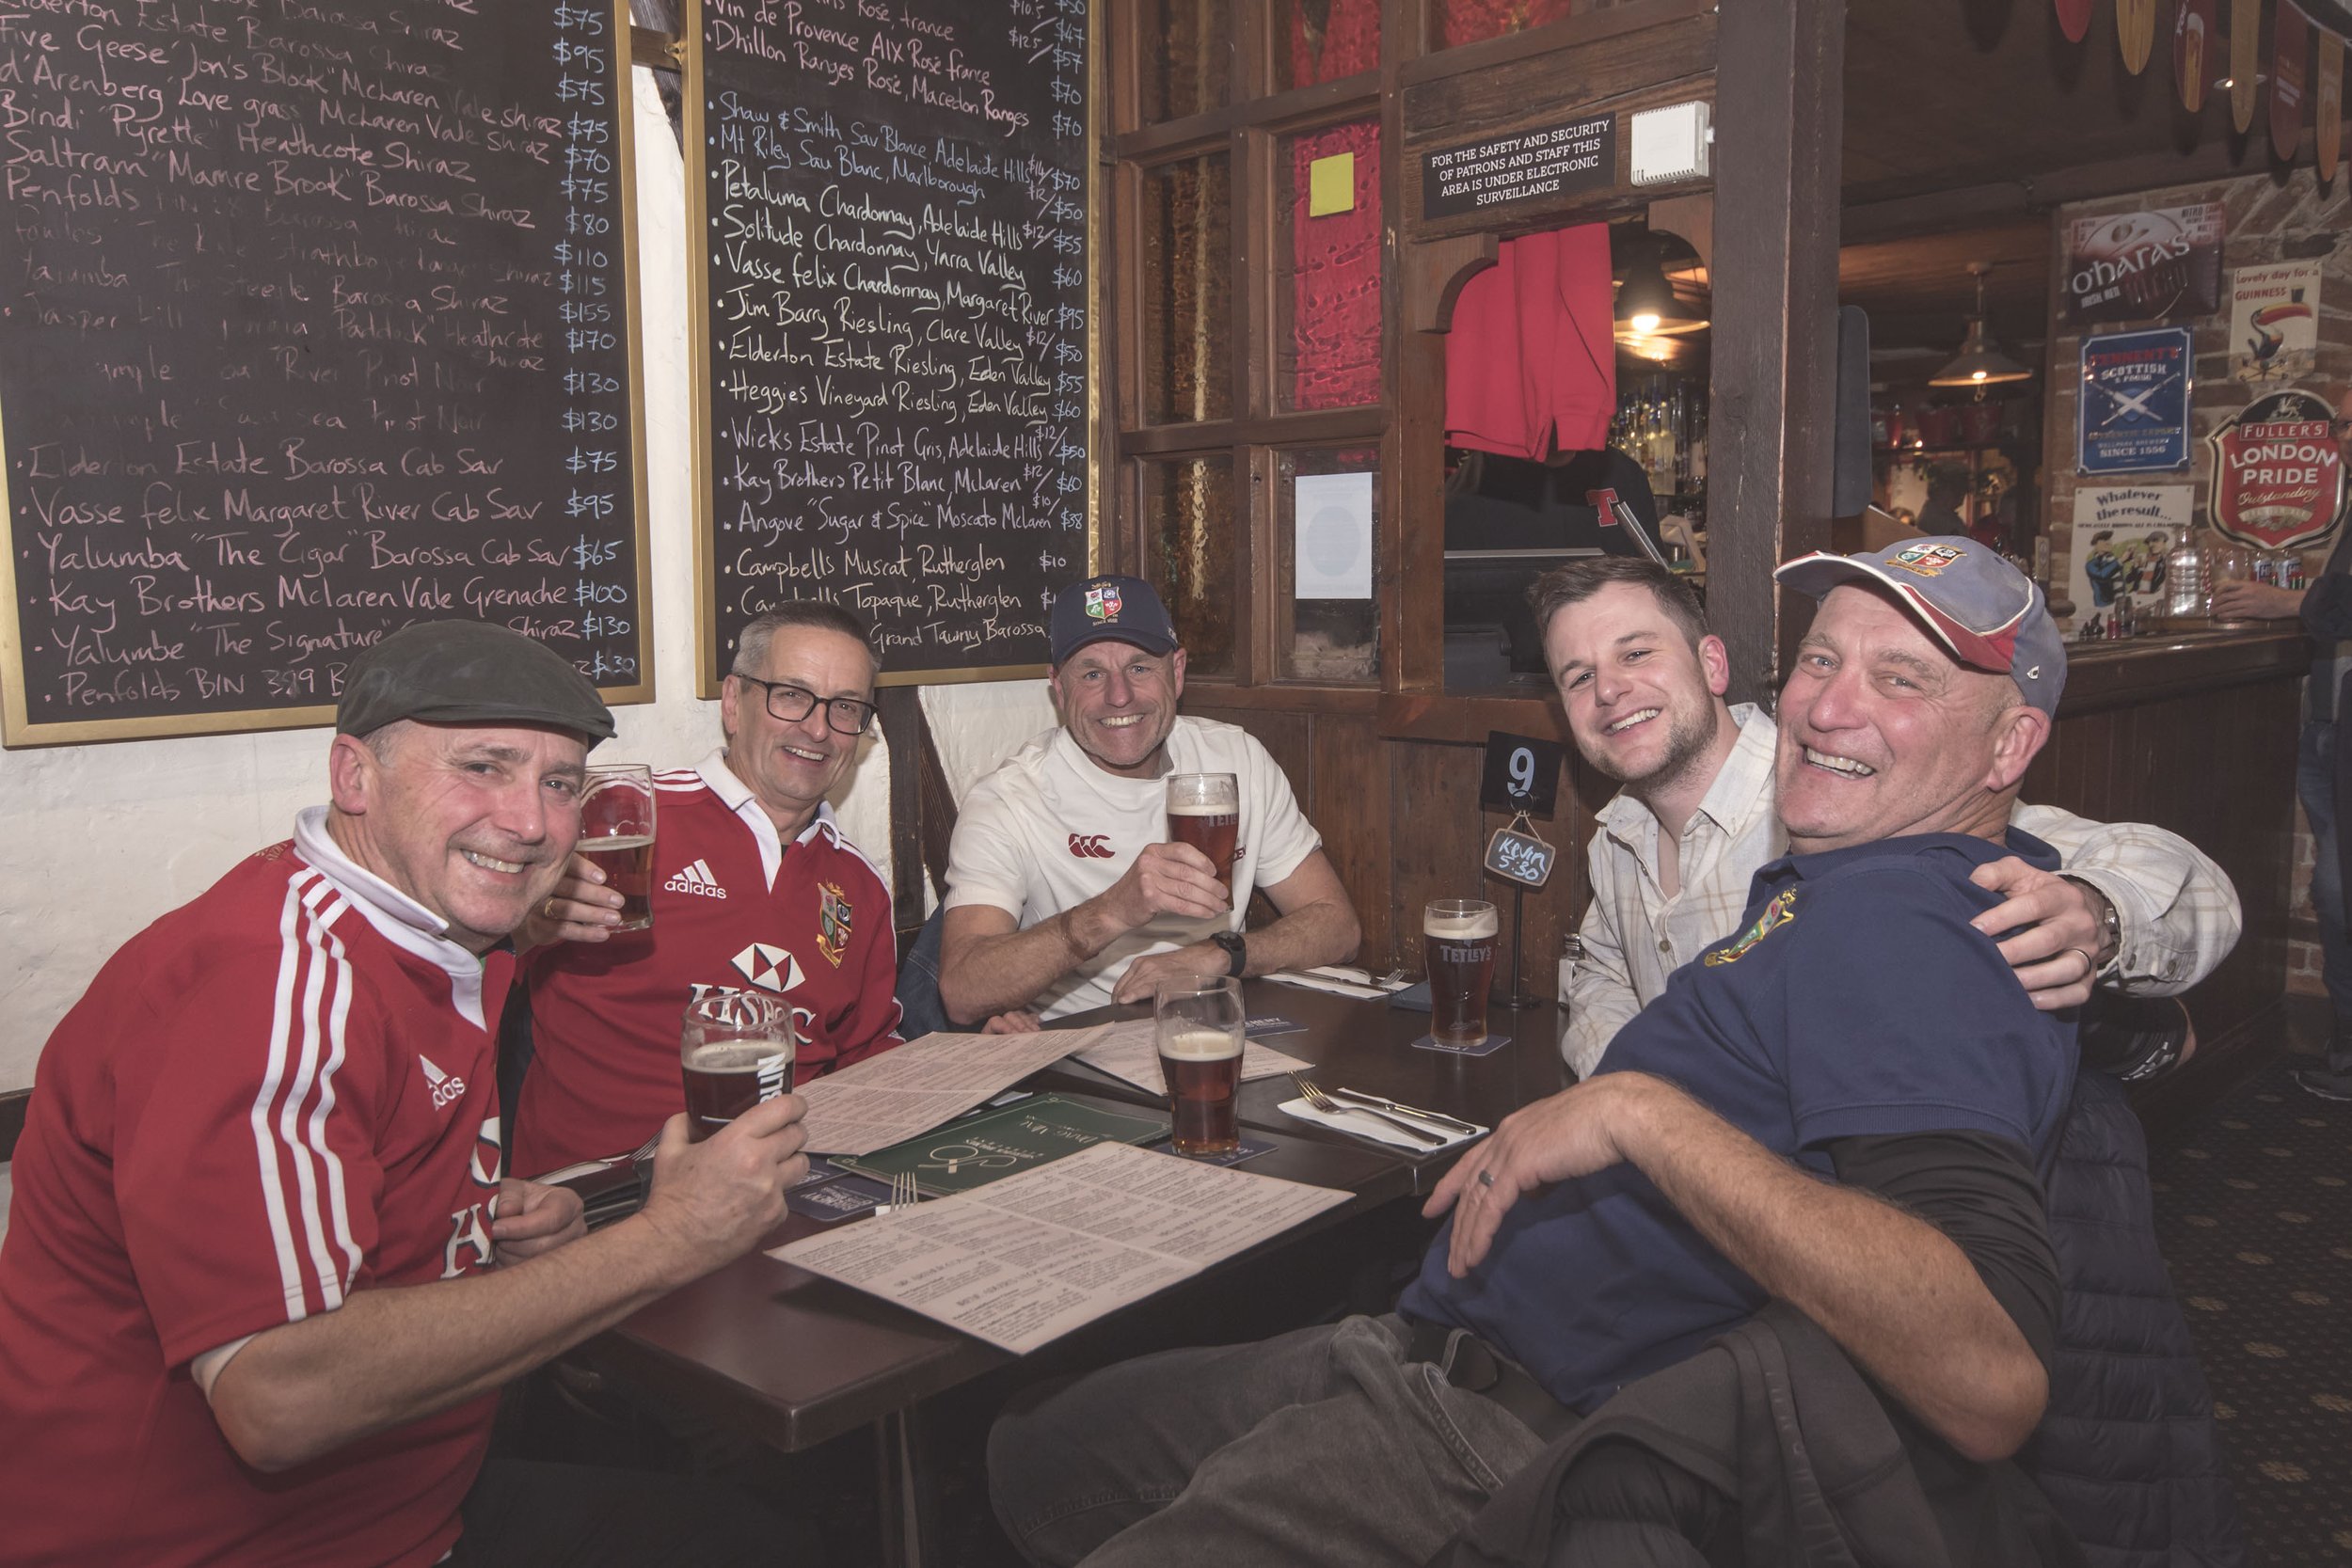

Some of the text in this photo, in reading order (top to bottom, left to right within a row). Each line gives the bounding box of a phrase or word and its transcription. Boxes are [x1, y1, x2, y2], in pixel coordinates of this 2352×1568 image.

[76, 24, 171, 66] Geese
[785, 2, 1082, 104] Provence $70
[555, 71, 605, 106] $75
[712, 20, 1082, 141] Dhillon Ranges Macedon Ranges $70
[566, 110, 610, 144] $75
[719, 92, 1081, 192] Shaw Smith Sav Adelaide $70
[1431, 119, 1610, 168] FOR THE SAFETY AND SECURITY
[5, 130, 151, 179] Saltram
[564, 141, 611, 174] $70
[721, 123, 1083, 224] Mt Riley Marlborough $50
[1439, 138, 1601, 182] OF PATRONS AND STAFF THIS
[561, 172, 609, 207] $75
[1441, 156, 1599, 198] AREA IS UNDER ELECTRONIC
[1476, 181, 1560, 206] SURVEILLANCE
[564, 205, 611, 235] $80
[724, 158, 1083, 254] Petaluma Adelaide Hills $55
[723, 204, 804, 248] Solitude
[978, 250, 1026, 292] Valley
[1053, 262, 1082, 290] $60
[725, 240, 1085, 331] Vasse Margaret River $95
[2235, 286, 2287, 302] GUINNESS
[2236, 271, 2267, 285] Lovely
[2270, 268, 2291, 282] day
[2294, 267, 2309, 279] for
[724, 284, 1083, 367] Jim Barry Clare Valley $50
[729, 326, 1085, 399] Elderton Estate Eden Valley $55
[2101, 363, 2168, 381] SCOTTISH
[728, 368, 1081, 428] Heggies Vineyard Eden Valley $60
[730, 415, 1087, 467] Wicks Estate Pinot Adelaide Hills $50
[2244, 422, 2324, 438] FULLER'S
[279, 436, 389, 482] Barossa
[401, 447, 446, 477] Cab
[457, 448, 504, 476] Sav
[565, 445, 619, 475] $75
[2099, 447, 2137, 458] SINCE
[2230, 444, 2338, 469] LONDON
[733, 454, 1083, 506] Kay Brothers Petit $60
[2238, 485, 2322, 506] Outstanding
[2242, 468, 2319, 485] PRIDE
[30, 482, 617, 537] Vasse Margaret River Cab Sav $95
[1585, 487, 1618, 527] T
[2096, 489, 2163, 507] Whatever
[2097, 509, 2119, 521] the
[738, 497, 1083, 548] Angove Moscato $38
[37, 530, 624, 577] Yalumba Barossa Cab Sav $65
[737, 542, 1067, 594] Campbells Rutherglen $10
[48, 574, 628, 634] Kay Brothers Vale Grenache $100
[927, 582, 1022, 623] Rutherglen
[580, 610, 631, 641] $130
[869, 617, 1047, 655] Grand Tawny Barossa
[57, 666, 246, 707] Penfolds BIN
[1507, 747, 1535, 798] 9
[1499, 837, 1546, 874] Kevin
[664, 879, 727, 899] adidas
[1439, 943, 1491, 963] TETLEY'S
